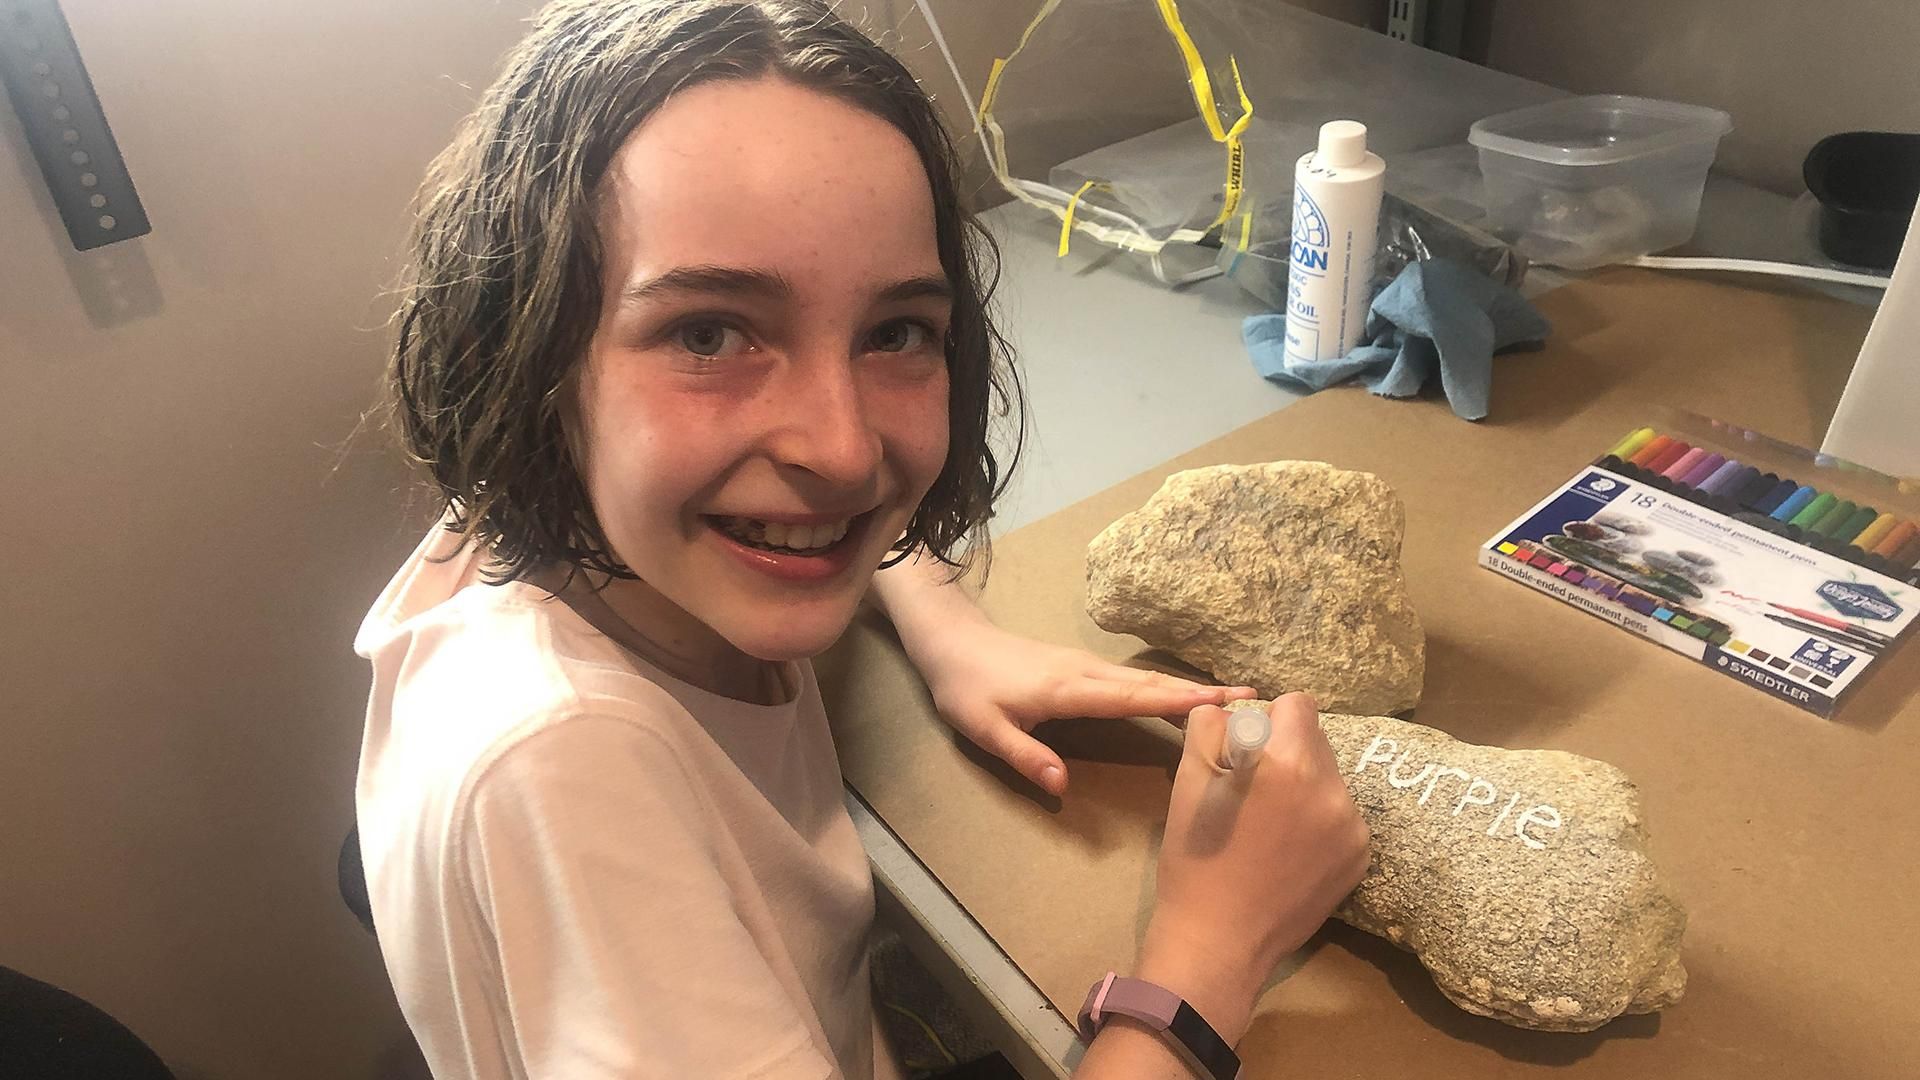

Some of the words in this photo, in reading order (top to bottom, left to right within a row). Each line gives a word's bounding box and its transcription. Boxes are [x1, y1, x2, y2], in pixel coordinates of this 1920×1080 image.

[1292, 241, 1329, 271] CAN
[1630, 492, 1657, 508] 18
[1661, 501, 1733, 534] Double-ended
[1731, 530, 1790, 556] permanent
[1487, 555, 1499, 567] 18
[1500, 560, 1567, 597] Double-ended
[1567, 591, 1623, 621] permanent
[1623, 615, 1649, 633] pens
[1729, 661, 1810, 703] STAEDTLER
[1793, 654, 1838, 677] UNIVERSAL
